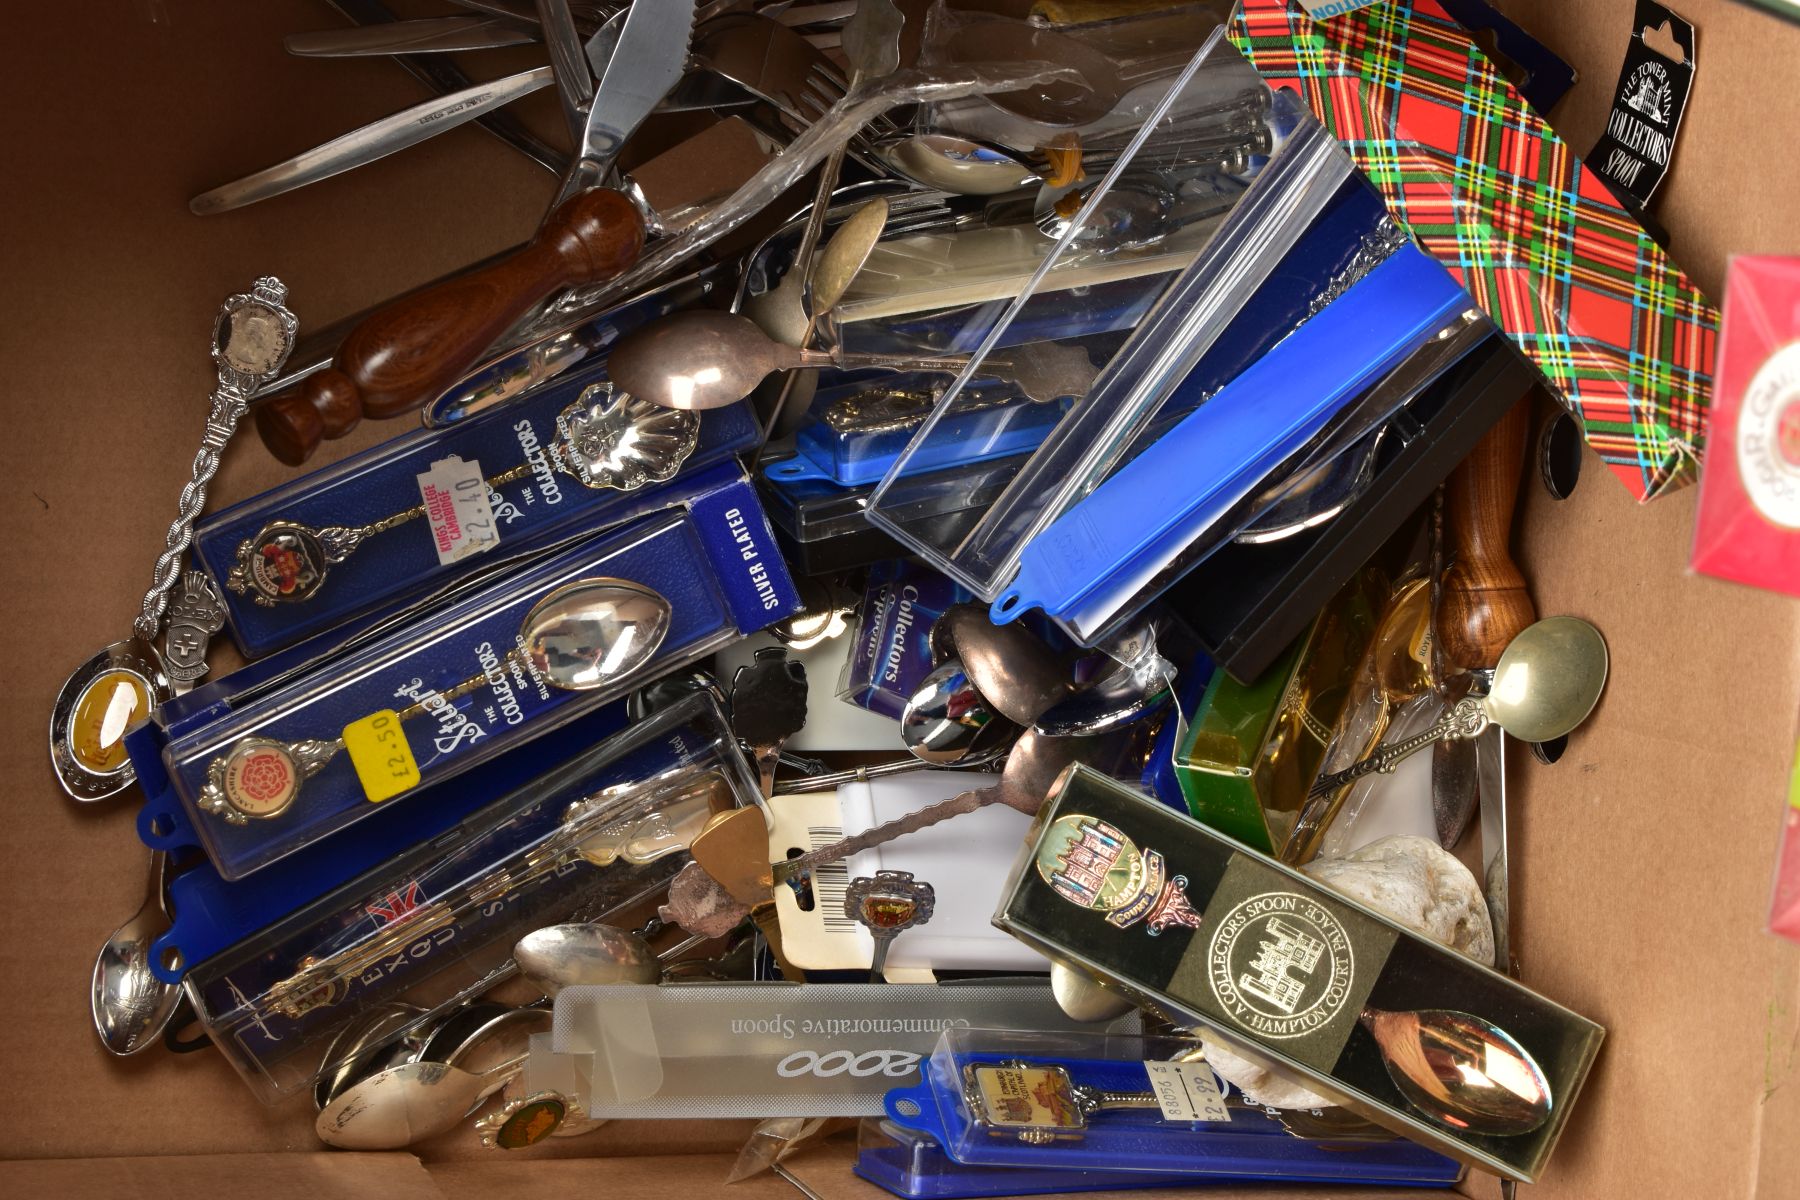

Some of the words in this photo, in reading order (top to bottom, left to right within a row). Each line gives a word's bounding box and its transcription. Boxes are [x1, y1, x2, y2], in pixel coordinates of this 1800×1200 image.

[1620, 72, 1637, 104] THE
[1637, 60, 1667, 84] TOWER
[1661, 80, 1672, 128] MINT
[1607, 108, 1671, 166] COLLECTORS
[1600, 147, 1646, 189] SPOON
[513, 419, 563, 505] COLLECTORS
[547, 443, 567, 473] SPOON
[556, 415, 591, 484] SILVERPLATED
[423, 484, 444, 523] COLLEGE
[437, 489, 462, 541] CAMBRIDGE
[521, 486, 536, 505] THE
[432, 523, 453, 553] KINGS
[725, 508, 758, 561] PLATED
[749, 565, 779, 610] SILVER
[885, 584, 919, 683] Collectors
[474, 641, 524, 726] COLLECTORS
[508, 659, 528, 690] SPOON
[515, 634, 550, 701] SILVERPLATED
[394, 677, 488, 754] Stuart
[484, 704, 497, 725] THE
[371, 716, 410, 778] £2.50
[229, 766, 254, 810] LANCASHIRE
[1101, 852, 1141, 907] HAMPTON
[1115, 895, 1149, 924] COURT
[1145, 855, 1159, 897] PALACE
[1245, 895, 1296, 917] SPOON
[1304, 903, 1346, 954] PALACE
[1213, 911, 1246, 1004] COLLECTORS
[1325, 957, 1349, 1007] COURT
[731, 1013, 796, 1040] Spoon
[802, 1018, 970, 1040] Commemorative
[1233, 1003, 1247, 1016] A
[1249, 1006, 1328, 1034] HAMPTON
[776, 1050, 923, 1078] 2000
[1163, 1080, 1183, 1116] 88056
